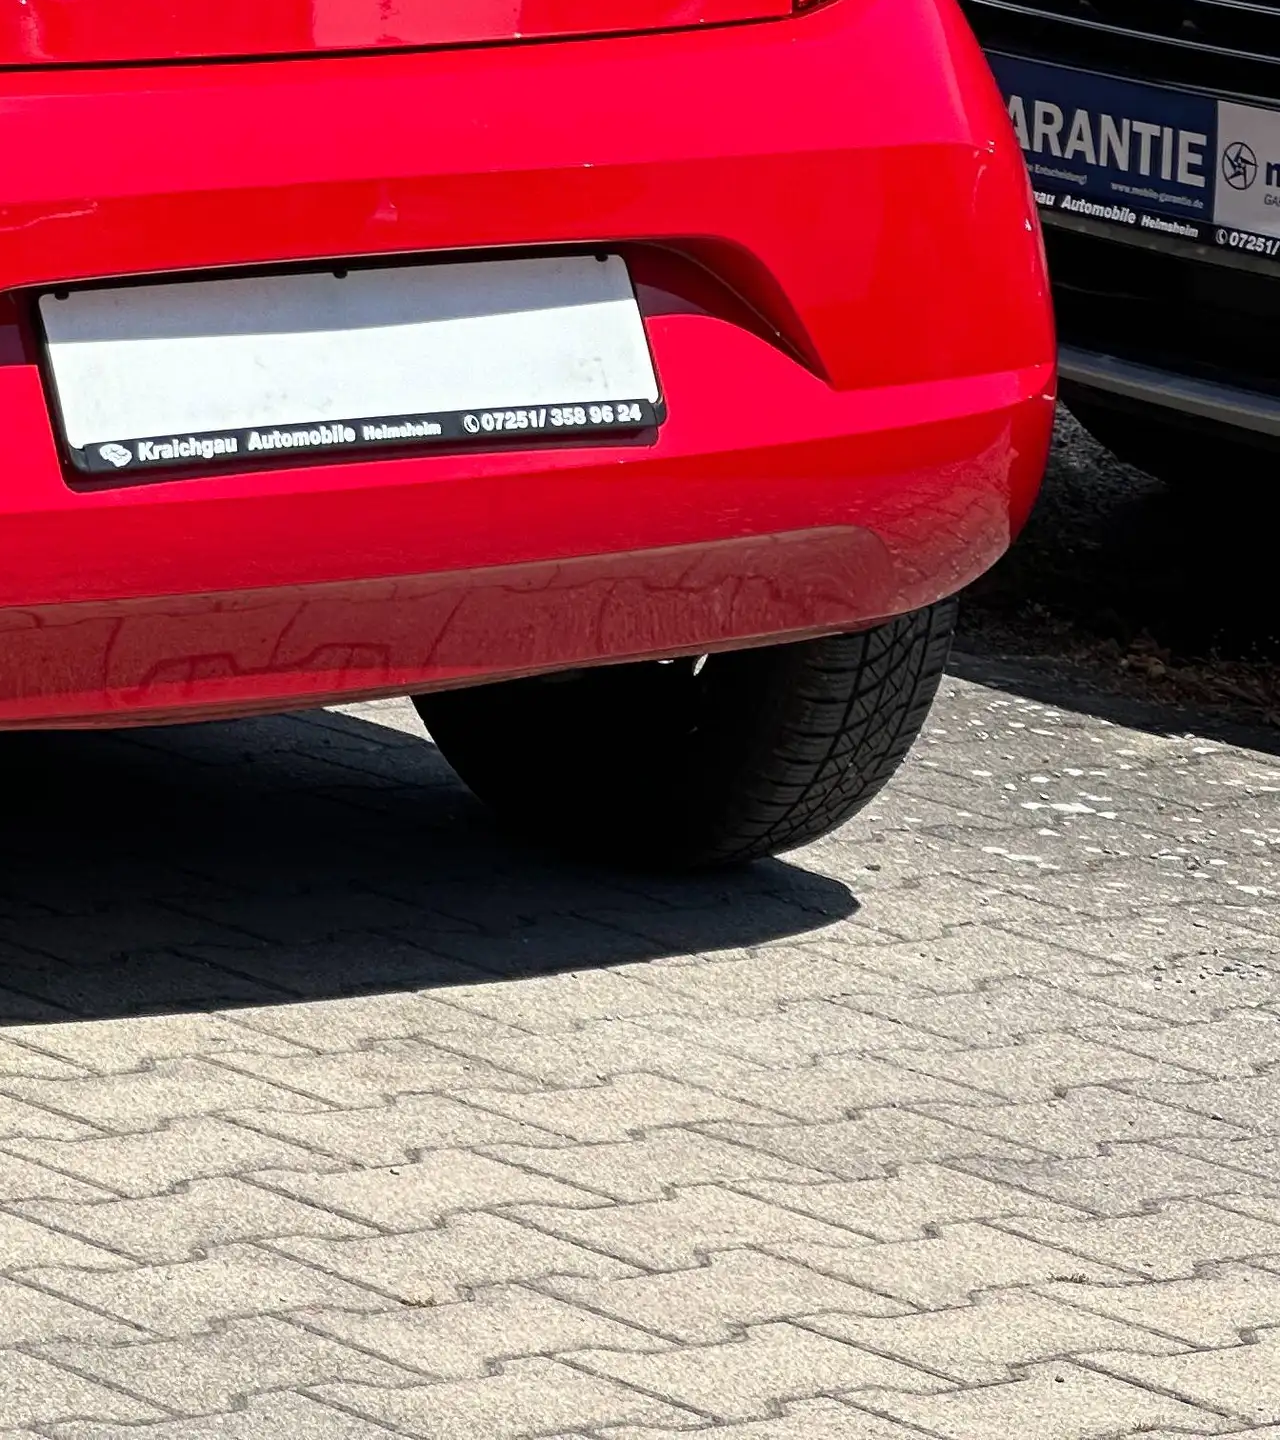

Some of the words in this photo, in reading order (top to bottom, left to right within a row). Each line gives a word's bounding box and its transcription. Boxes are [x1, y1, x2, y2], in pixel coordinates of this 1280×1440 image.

[1061, 194, 1137, 224] Automobile
[1229, 231, 1280, 255] 07251/
[138, 436, 238, 461] Kraichgau
[248, 423, 356, 451] Automobile
[481, 408, 547, 431] 07251/
[550, 406, 587, 427] 358
[590, 405, 614, 424] 96
[617, 403, 642, 422] 24
